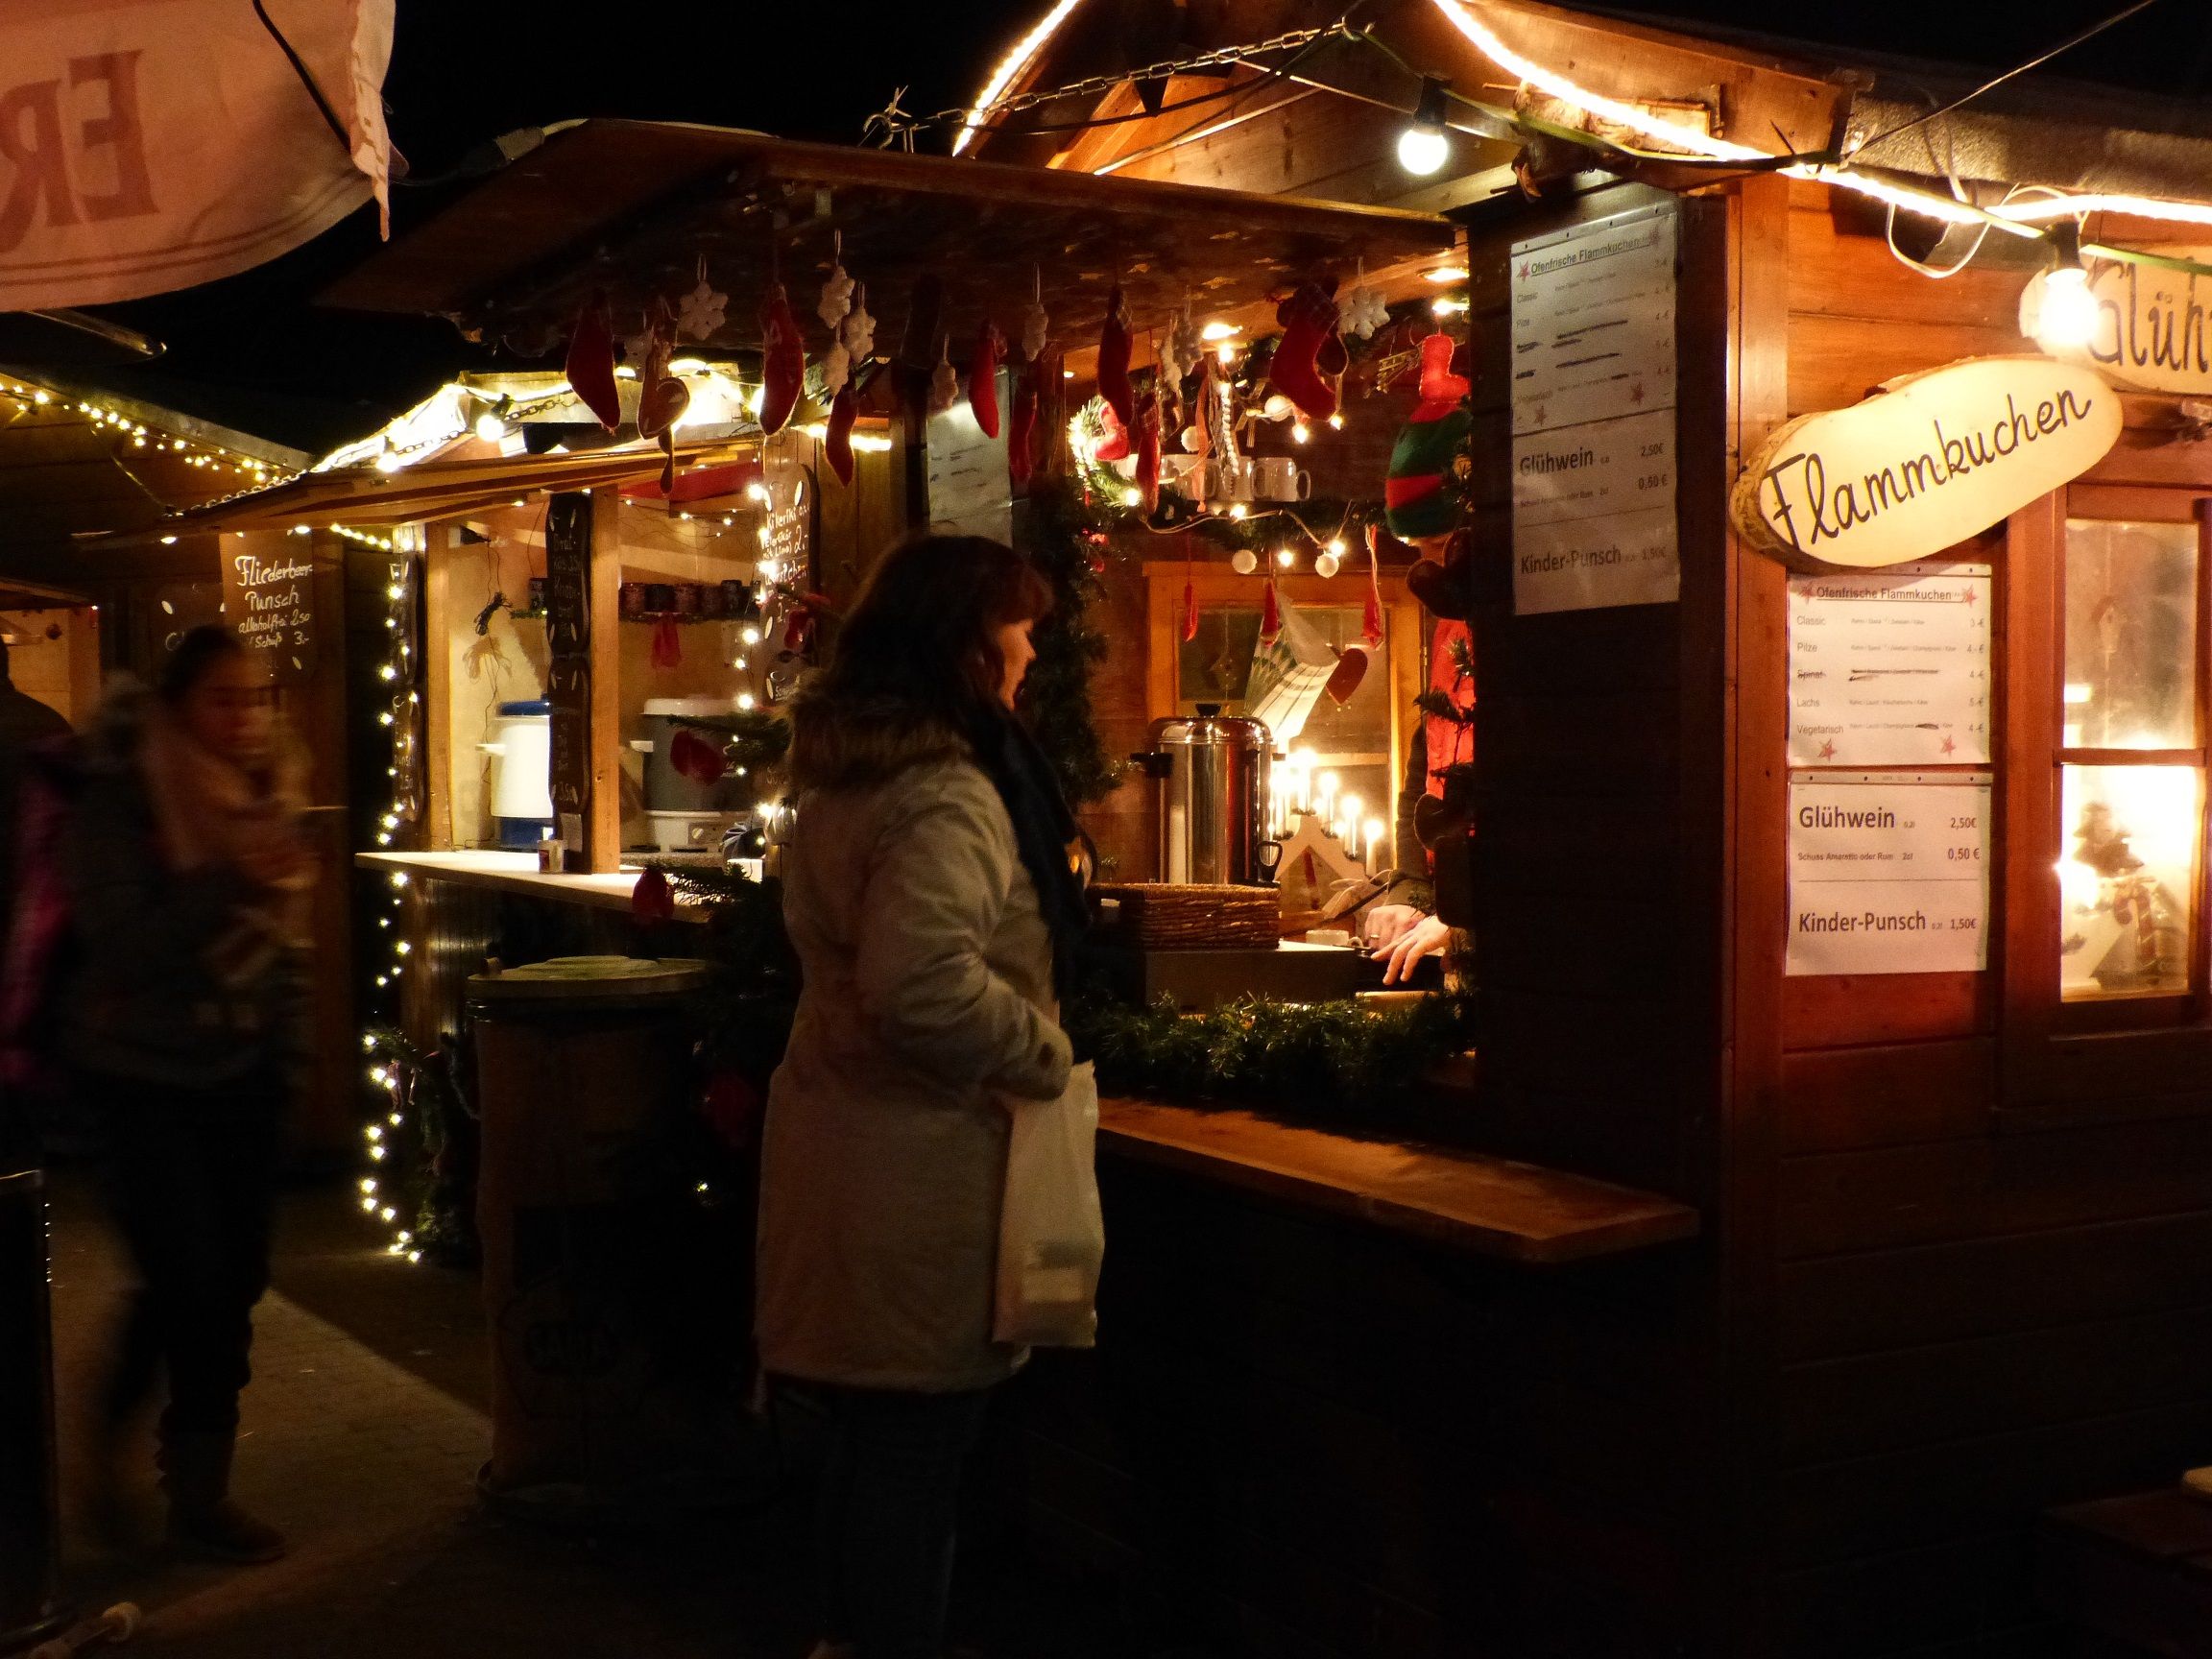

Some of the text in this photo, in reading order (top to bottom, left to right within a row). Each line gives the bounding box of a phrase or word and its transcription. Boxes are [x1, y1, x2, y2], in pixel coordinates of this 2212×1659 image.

[1530, 252, 1576, 274] Ofenfrische
[2087, 256, 2212, 373] Glüh
[1520, 446, 1594, 476] Glühwein
[1766, 389, 2092, 550] Flammkuchen
[1521, 544, 1622, 574] Kinder-Punsch
[245, 585, 300, 612] Punsch
[1816, 587, 1952, 600] Ofenfrische Flammkuchen
[1796, 615, 1826, 626] Classic
[1796, 642, 1818, 653] Pilze
[1796, 697, 1820, 708] Lachs
[1796, 725, 1844, 735] Vegetarisch
[1799, 805, 1896, 829] Glühwein
[1950, 817, 1978, 830] 2,50€
[1797, 853, 1824, 861] Schuss
[1825, 853, 1859, 861] Amaretto
[1859, 853, 1877, 861] oder
[1877, 853, 1894, 861] Rum
[1947, 848, 1970, 861] 0,50
[1972, 848, 1981, 860] €
[1798, 911, 1926, 932] Kinder-Punsch
[1950, 918, 1977, 930] 1,50€
